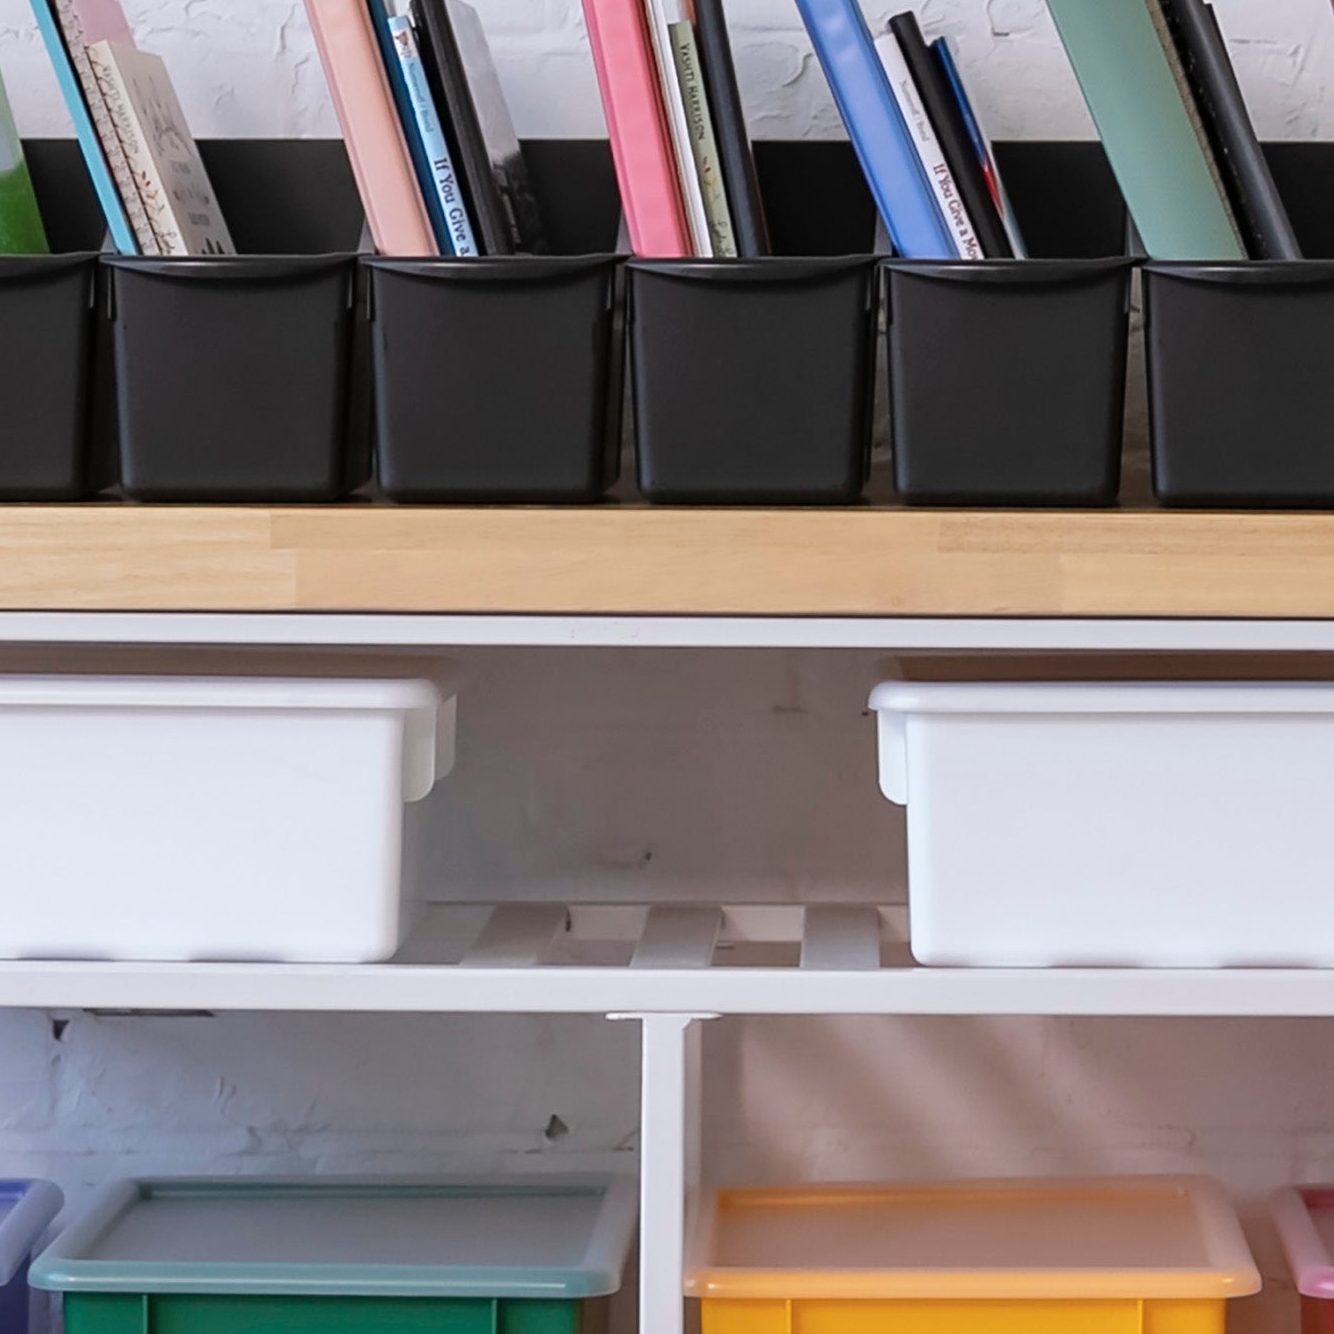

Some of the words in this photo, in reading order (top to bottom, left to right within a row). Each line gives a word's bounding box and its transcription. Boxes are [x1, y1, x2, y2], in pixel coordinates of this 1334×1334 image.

[680, 43, 695, 84] VASHTI
[687, 85, 705, 140] HARRISON
[434, 158, 450, 172] If
[933, 163, 946, 175] If
[439, 174, 455, 203] You
[938, 175, 953, 199] You
[449, 207, 466, 242] Give
[948, 199, 965, 228] Give
[959, 227, 969, 238] a
[459, 245, 470, 255] a
